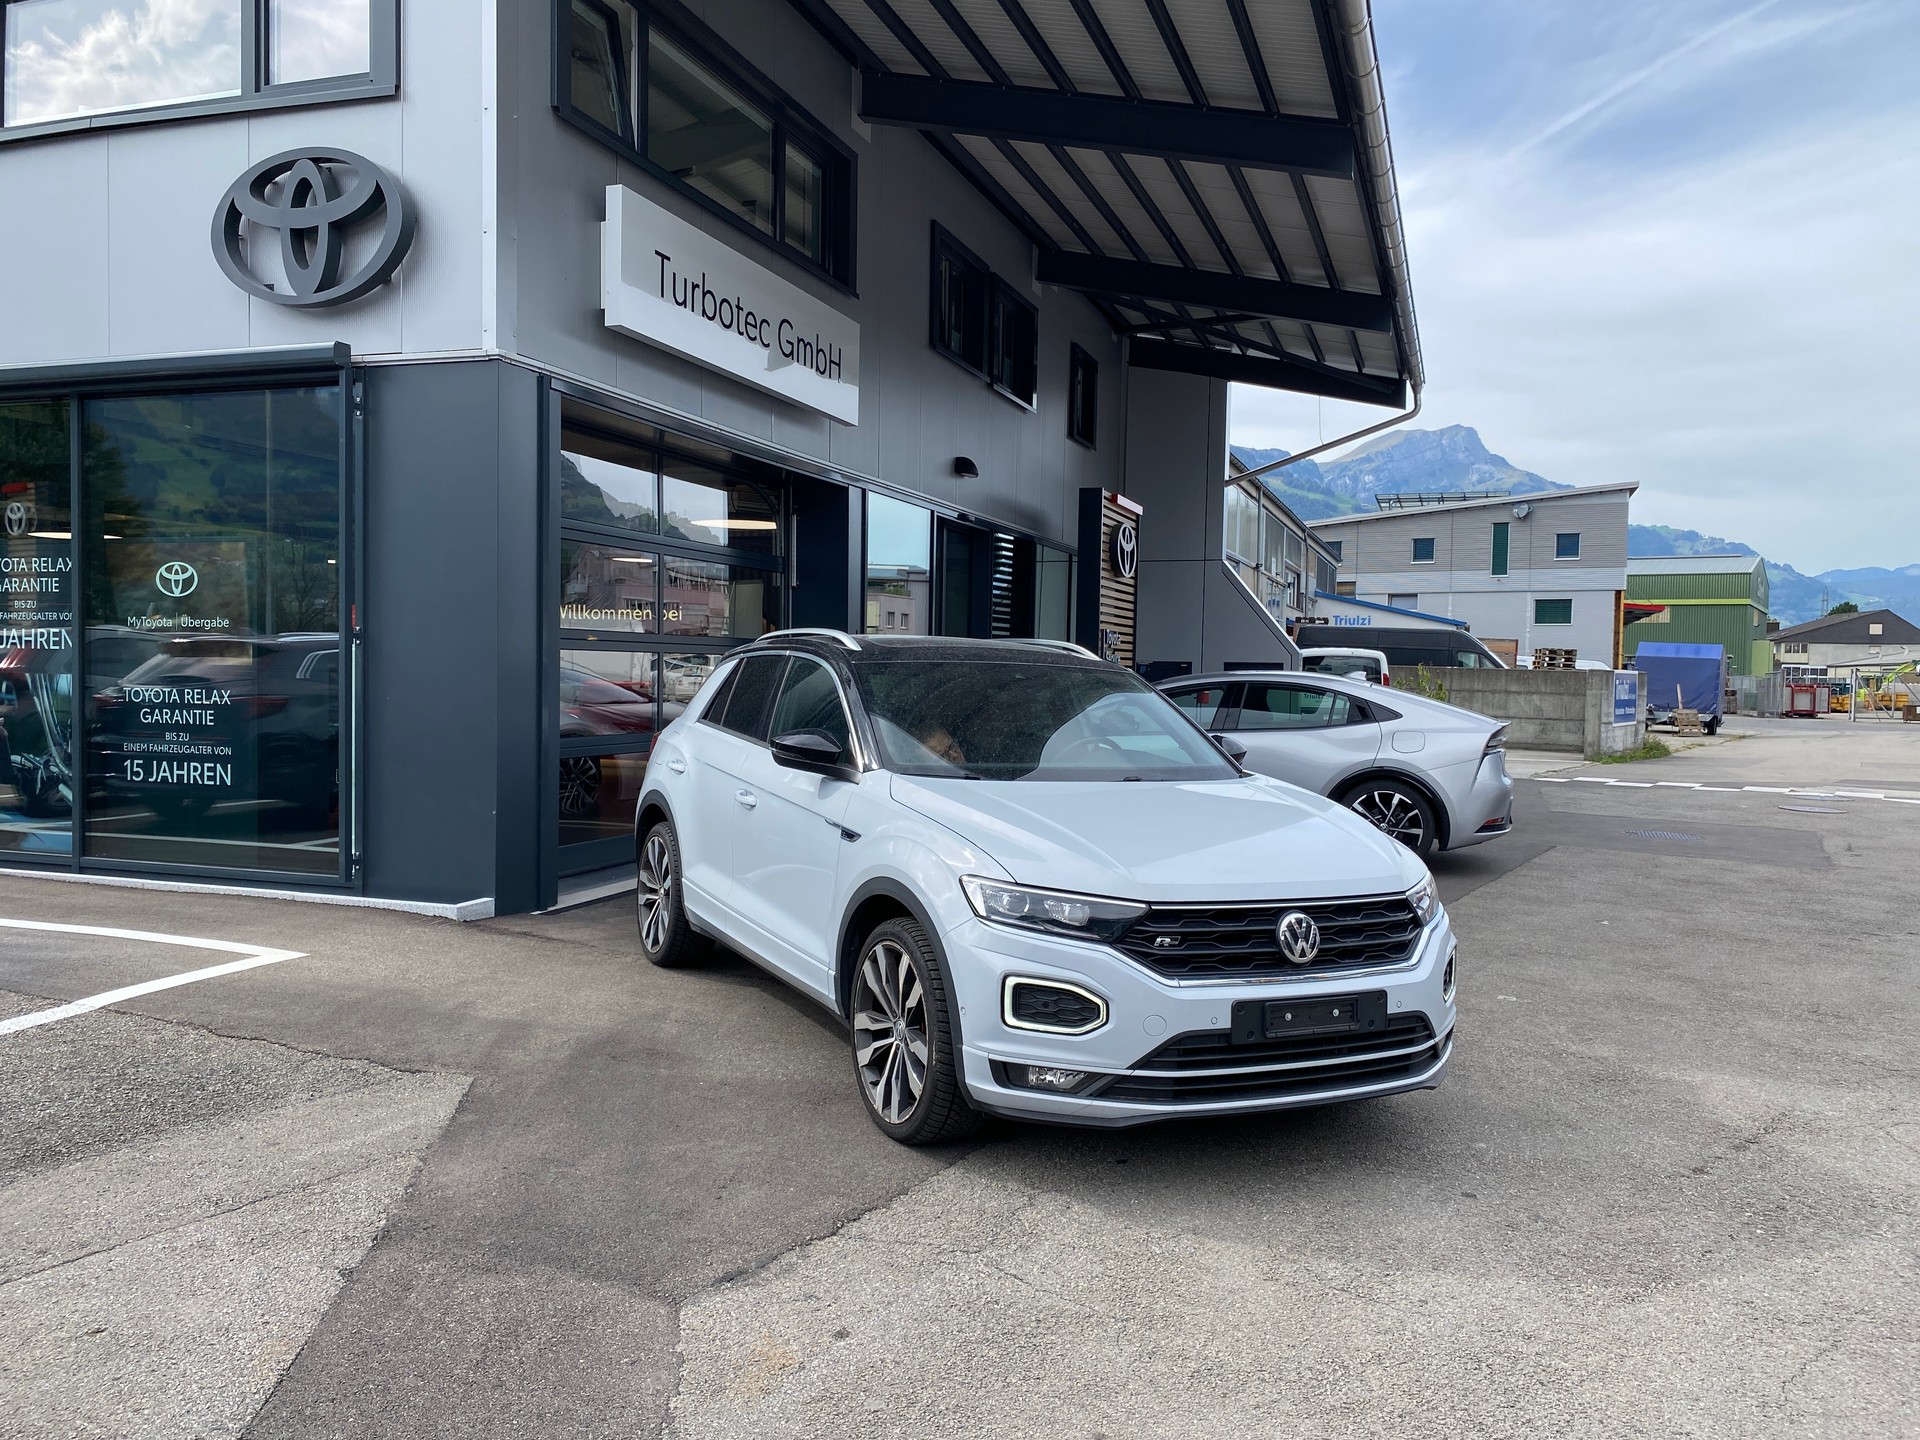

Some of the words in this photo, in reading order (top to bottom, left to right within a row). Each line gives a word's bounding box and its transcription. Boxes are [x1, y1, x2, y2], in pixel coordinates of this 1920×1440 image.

[655, 249, 770, 348] Turbotec
[778, 318, 842, 381] GmbH
[0, 558, 28, 572] OTA
[0, 577, 60, 592] ARANTIE
[14, 600, 26, 609] BIS
[27, 600, 37, 609] ZU
[127, 616, 172, 630] MyToyota
[181, 614, 230, 630] Übergabe
[1333, 614, 1371, 626] Triulzi
[123, 687, 180, 704] TOYOTA
[184, 688, 231, 705] RELAX
[140, 708, 214, 726] GARANTIE
[165, 732, 177, 741] BIS
[179, 732, 190, 741] ZU
[123, 742, 148, 752] EINEM
[149, 743, 213, 755] FAHRZEUGALTER
[214, 746, 232, 756] VON
[123, 759, 144, 782] 15
[148, 760, 231, 786] JAHREN
